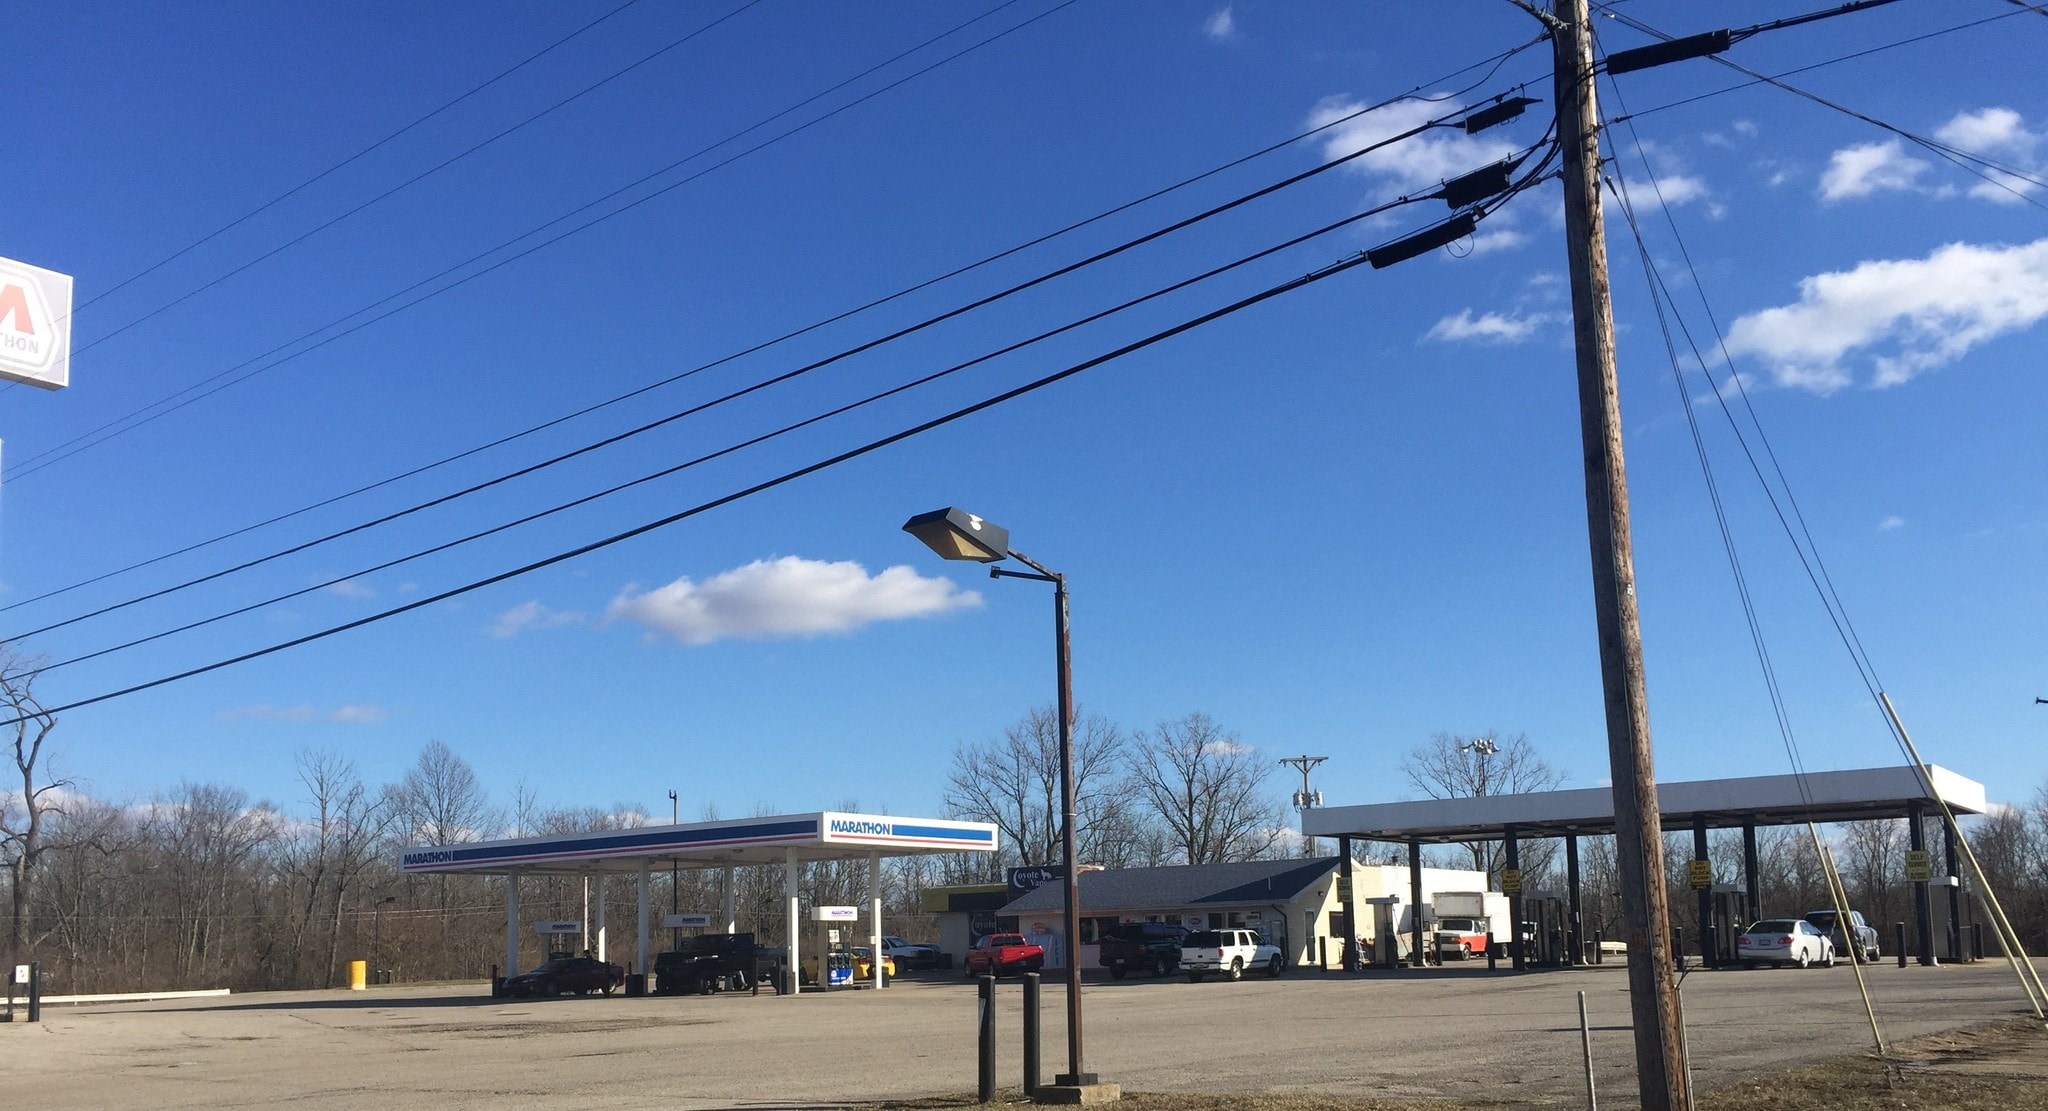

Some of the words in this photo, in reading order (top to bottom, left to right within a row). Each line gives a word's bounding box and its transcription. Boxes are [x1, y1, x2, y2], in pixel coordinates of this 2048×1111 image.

[831, 820, 890, 835] MARATHON
[404, 851, 451, 865] MARATHON
[1013, 869, 1039, 888] Coyote
